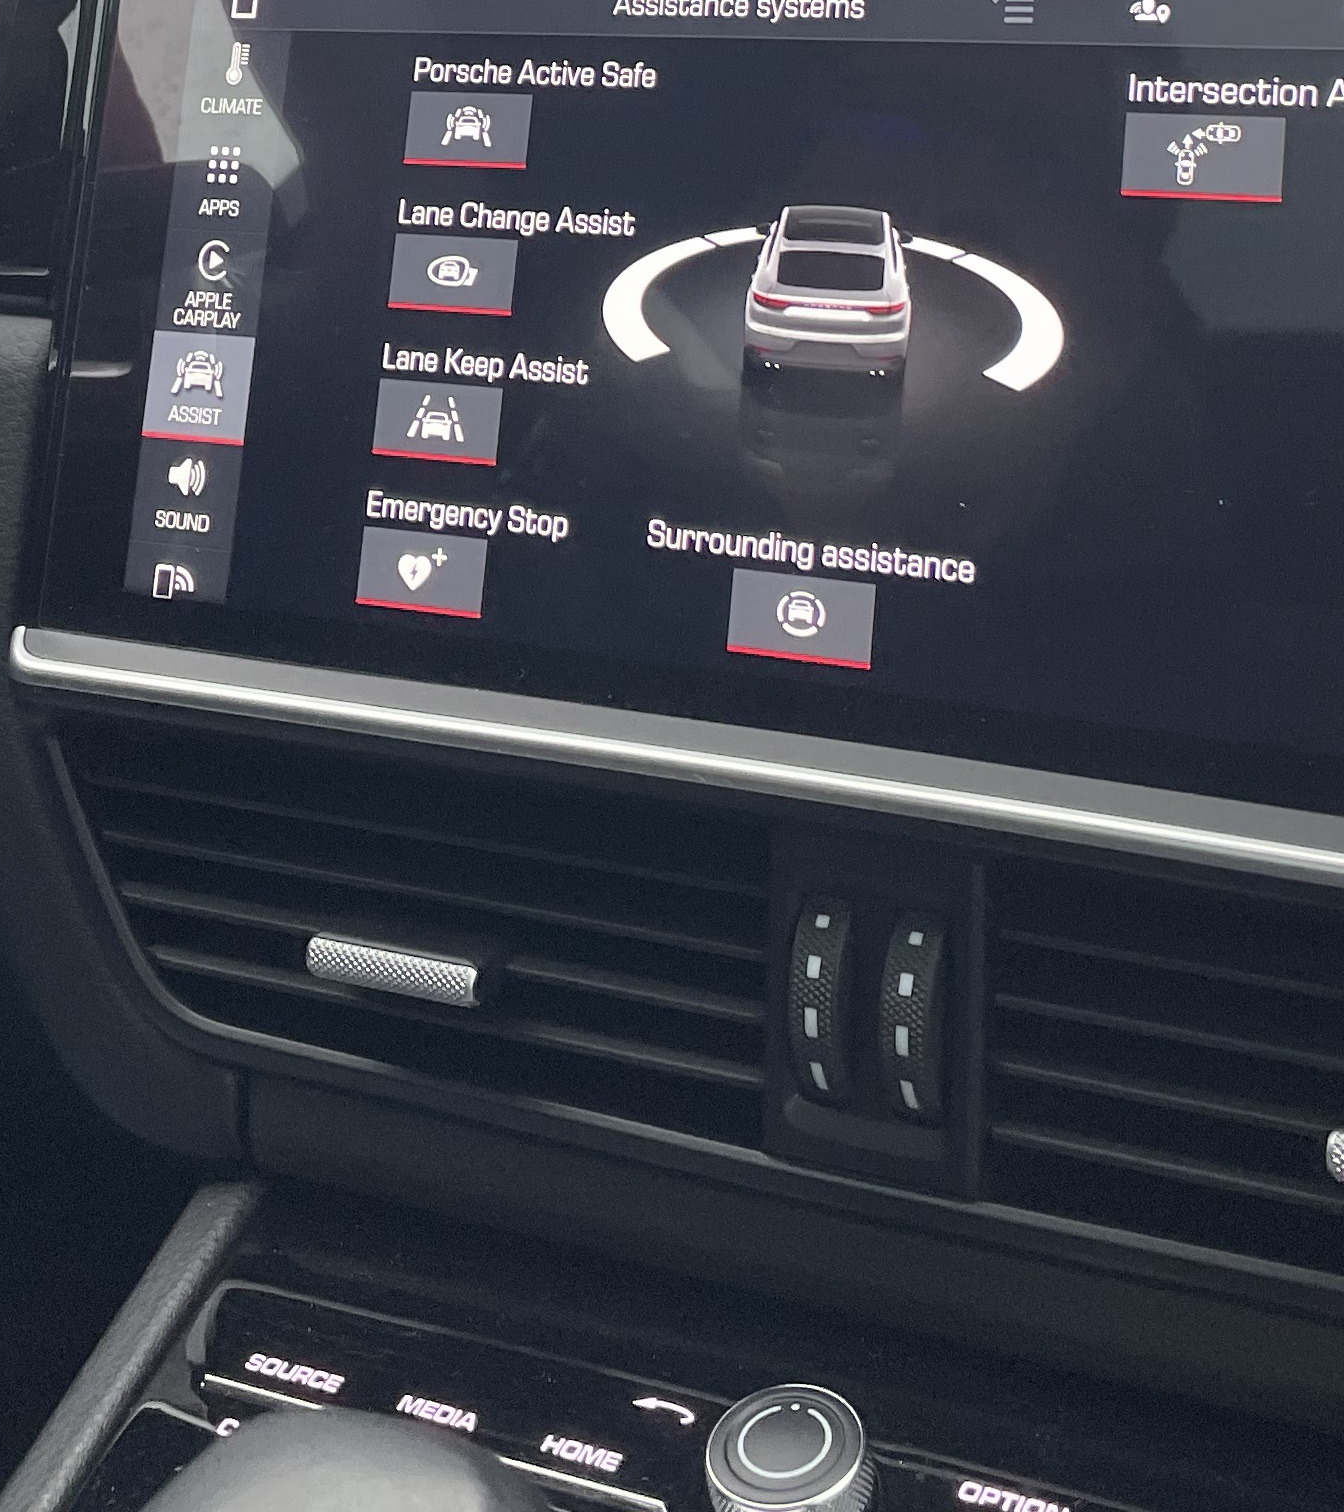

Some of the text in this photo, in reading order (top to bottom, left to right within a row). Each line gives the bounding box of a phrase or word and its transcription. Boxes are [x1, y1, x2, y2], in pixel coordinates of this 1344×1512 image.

[413, 56, 657, 89] Porsche Active Safe
[200, 97, 264, 116] CLIMATE
[1127, 73, 1318, 107] Intersection
[198, 199, 240, 218] APPS
[398, 198, 636, 237] Lane Change Assist
[184, 290, 234, 311] APPLE
[173, 308, 242, 330] CARPLAY
[382, 342, 590, 386] Lane Keep Assist
[167, 405, 223, 426] ASSIST
[155, 509, 211, 533] SOUND
[366, 490, 569, 540] Emergency Stop
[646, 519, 976, 584] Surrounding assistance
[244, 1352, 346, 1394] SOURCE
[396, 1394, 479, 1434] MEDIA
[539, 1433, 625, 1473] HOME
